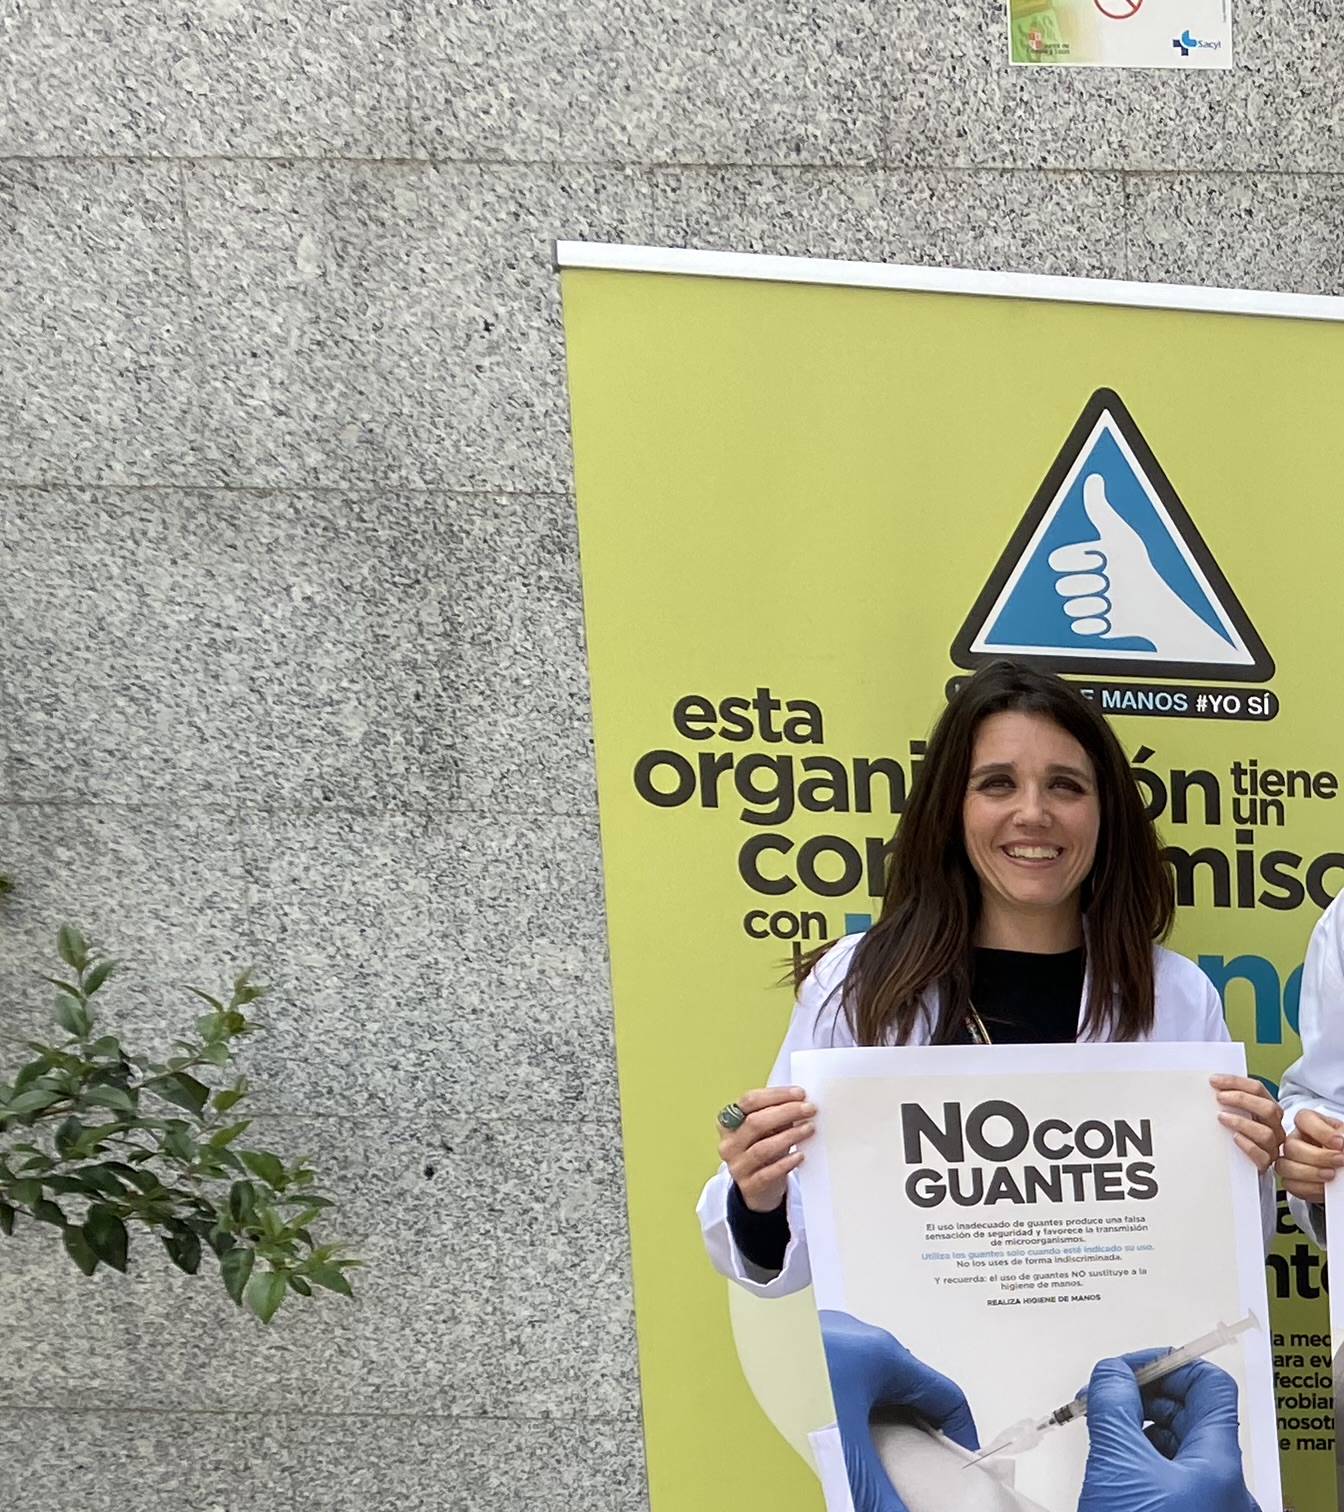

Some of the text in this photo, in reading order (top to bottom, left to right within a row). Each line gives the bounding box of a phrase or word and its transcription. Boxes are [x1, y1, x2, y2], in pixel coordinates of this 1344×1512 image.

[1198, 40, 1221, 49] Sacyl
[1102, 689, 1188, 711] MANOS
[1196, 693, 1240, 714] #YO
[1247, 693, 1270, 715] SÍ
[673, 688, 824, 744] esta
[1230, 759, 1338, 799] tiene
[1232, 797, 1285, 826] un
[744, 910, 827, 940] con
[901, 1100, 1153, 1164] NO CON
[905, 1162, 1159, 1208] GUANTES
[926, 1222, 935, 1231] El
[956, 1220, 1010, 1229] inadecuado
[1013, 1219, 1024, 1227] de
[1027, 1218, 1063, 1229] guantes
[1066, 1216, 1103, 1228] produce
[1125, 1215, 1145, 1223] falsa
[926, 1230, 971, 1240] sensación
[973, 1230, 985, 1238] de
[988, 1228, 1033, 1240] seguridad
[1044, 1226, 1083, 1235] favorece
[1085, 1225, 1093, 1233] la
[1096, 1223, 1148, 1233] transmisión
[990, 1237, 1003, 1245] de
[956, 1259, 970, 1267] No
[972, 1258, 986, 1267] los
[1011, 1257, 1022, 1265] de
[1025, 1256, 1052, 1265] forma
[990, 1273, 998, 1281] el
[1019, 1272, 1030, 1280] de
[1033, 1270, 1069, 1282] guantes
[1071, 1270, 1086, 1278] NO
[1089, 1268, 1129, 1280] sustituye
[1139, 1267, 1147, 1275] la
[1001, 1281, 1035, 1292] higiene
[1037, 1280, 1049, 1288] de
[987, 1294, 1101, 1306] REALIZA HIGIENE DE MANOS
